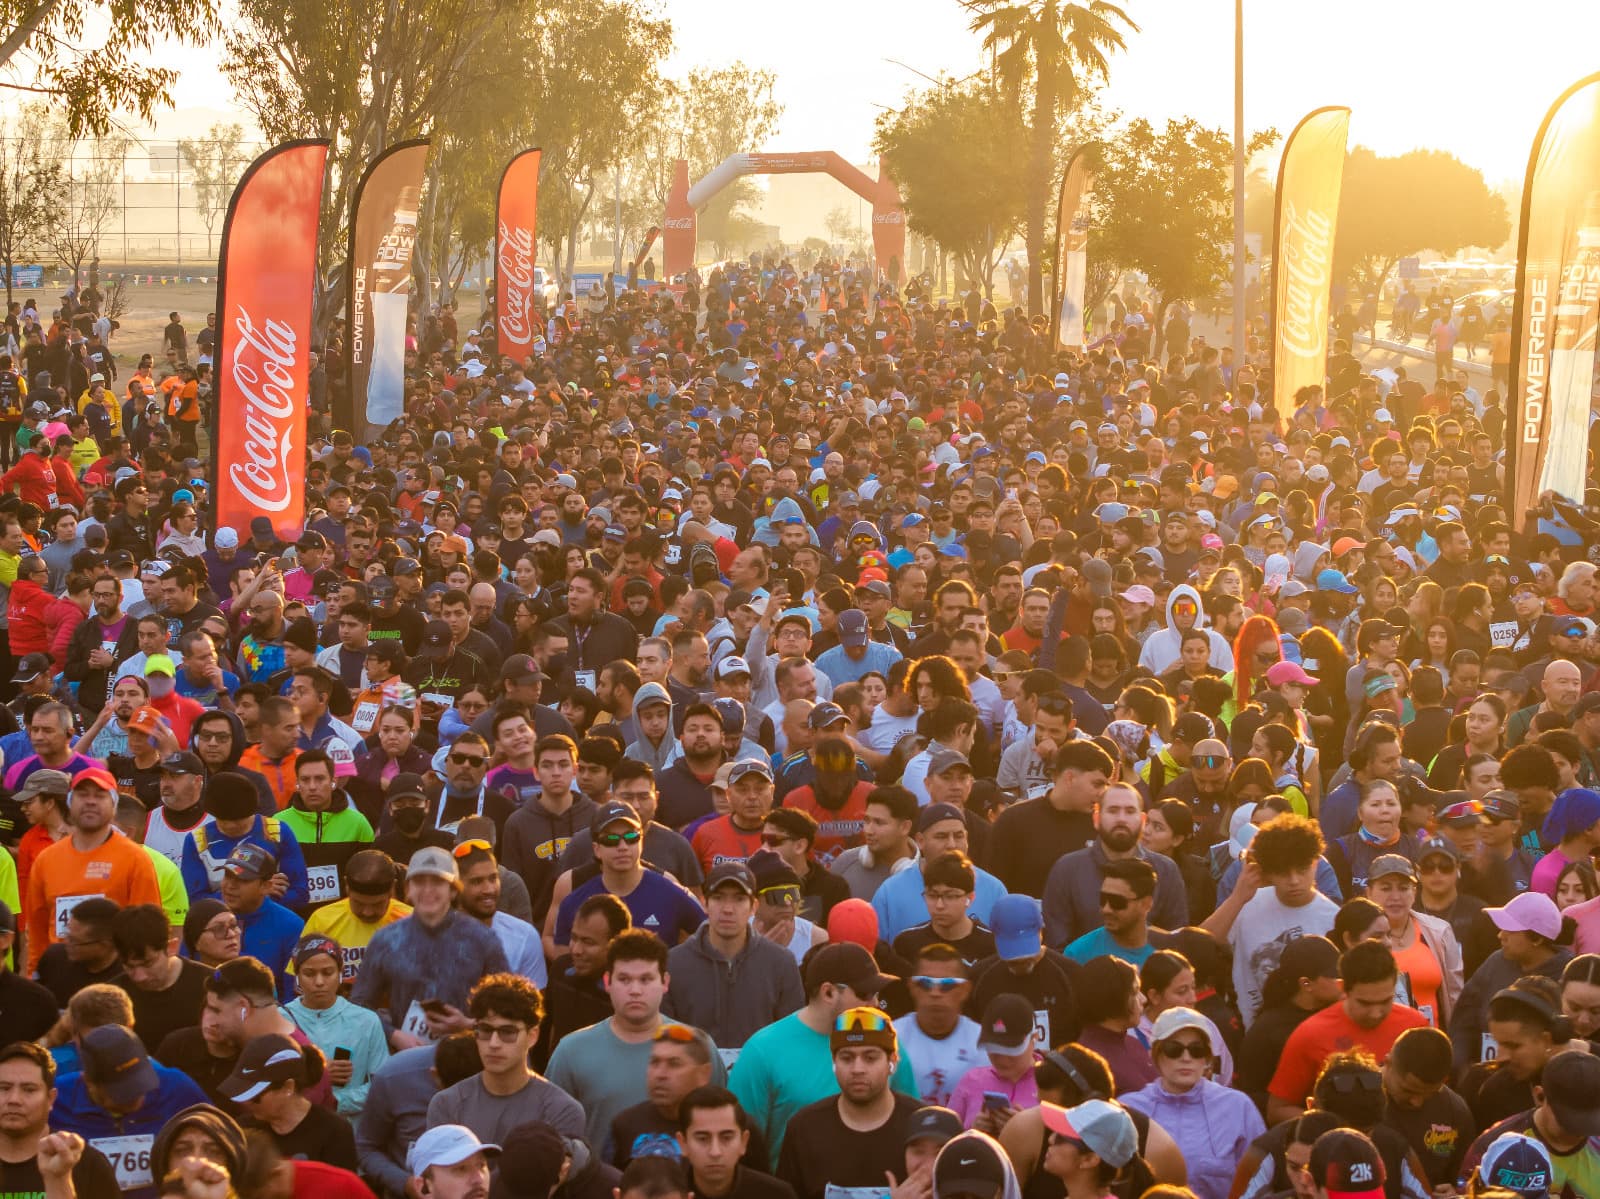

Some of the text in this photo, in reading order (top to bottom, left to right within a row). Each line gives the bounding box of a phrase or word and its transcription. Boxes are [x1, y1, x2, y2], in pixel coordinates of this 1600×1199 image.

[353, 266, 367, 364] POWERADE
[1523, 278, 1548, 443] POWERADE
[229, 303, 297, 512] Coca-Cola
[1493, 628, 1517, 641] 0258
[308, 875, 336, 891] 396
[109, 1150, 151, 1172] 766
